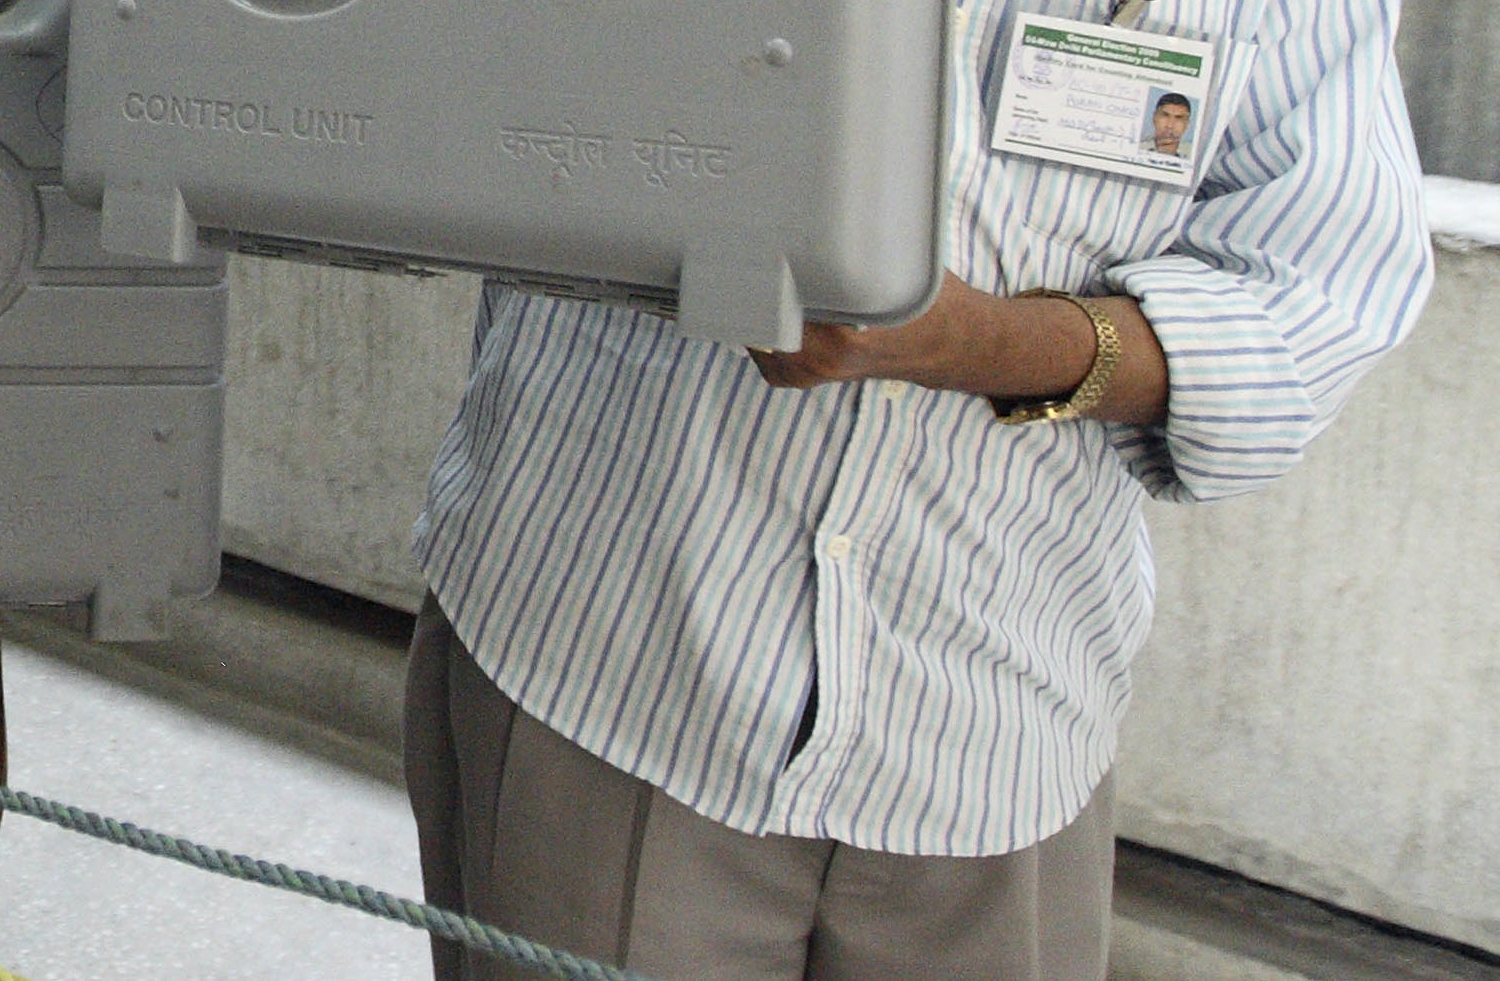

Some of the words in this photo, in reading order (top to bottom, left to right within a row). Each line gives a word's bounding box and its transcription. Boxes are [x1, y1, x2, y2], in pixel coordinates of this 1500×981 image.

[122, 90, 282, 139] CONTROL
[290, 106, 375, 146] UNIT
[631, 131, 734, 189] यूनिट
